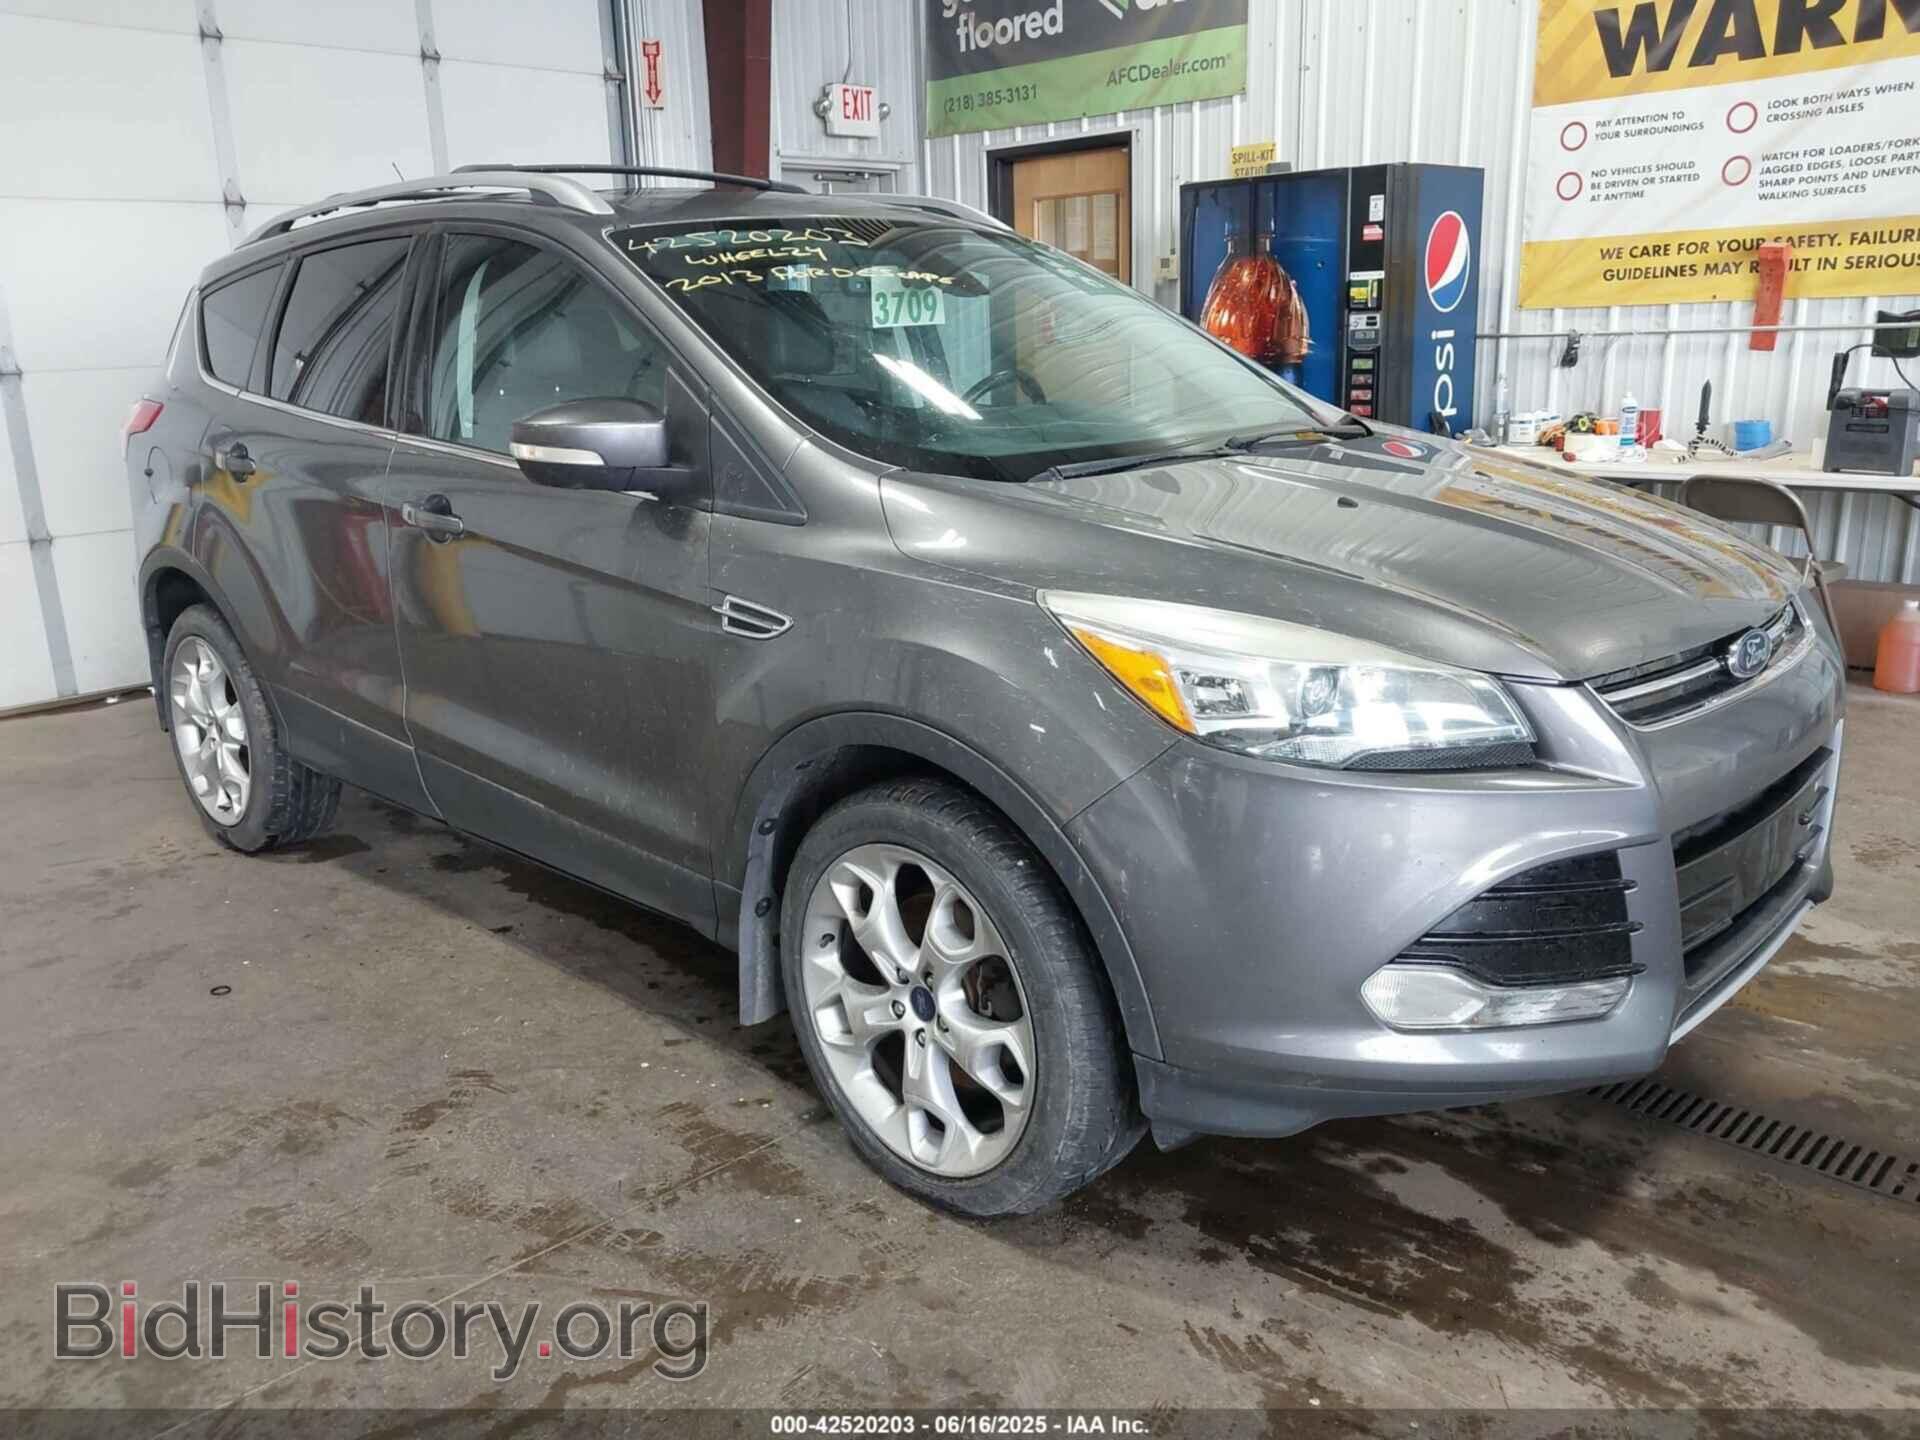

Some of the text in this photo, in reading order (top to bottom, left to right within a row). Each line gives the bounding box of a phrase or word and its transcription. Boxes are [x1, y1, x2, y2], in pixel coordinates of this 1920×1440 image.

[956, 0, 1063, 52] floored
[842, 88, 872, 121] EXIT
[943, 84, 1038, 113] (218) 385-3131
[1768, 81, 1915, 110] LOOK BOTH WAYS WHEN
[1595, 110, 1686, 129] PAY ATTENTION TO
[1766, 102, 1865, 123] CROSSING AISLES
[1595, 121, 1705, 141] YOUR SURROUNDINGS
[1232, 149, 1274, 165] SPILL-KIT
[1760, 162, 1804, 176] JAGGED
[1807, 159, 1845, 171] EDGES,
[1849, 154, 1887, 167] LOOSE
[1761, 150, 1799, 162] WATCH
[1803, 147, 1826, 158] FOR
[1591, 160, 1696, 179] NO VEHICLES SHOULD
[1759, 165, 1920, 189] SHARP POINTS AND UNEVEN
[1590, 172, 1701, 191] BE DRIVEN OR STARTED
[1758, 183, 1867, 201] WALKING SURFACES
[1590, 190, 1645, 202] AT ANYTIME
[627, 227, 869, 254] 42520203
[1599, 246, 1625, 260] WE
[1629, 243, 1671, 259] CARE
[1677, 240, 1710, 256] FOR
[665, 269, 763, 292] 2013
[771, 265, 855, 280] FORD
[1603, 263, 1698, 282] GUIDELINES
[1703, 260, 1744, 276] MAY
[1817, 257, 1838, 271] IN
[874, 290, 938, 325] 3709
